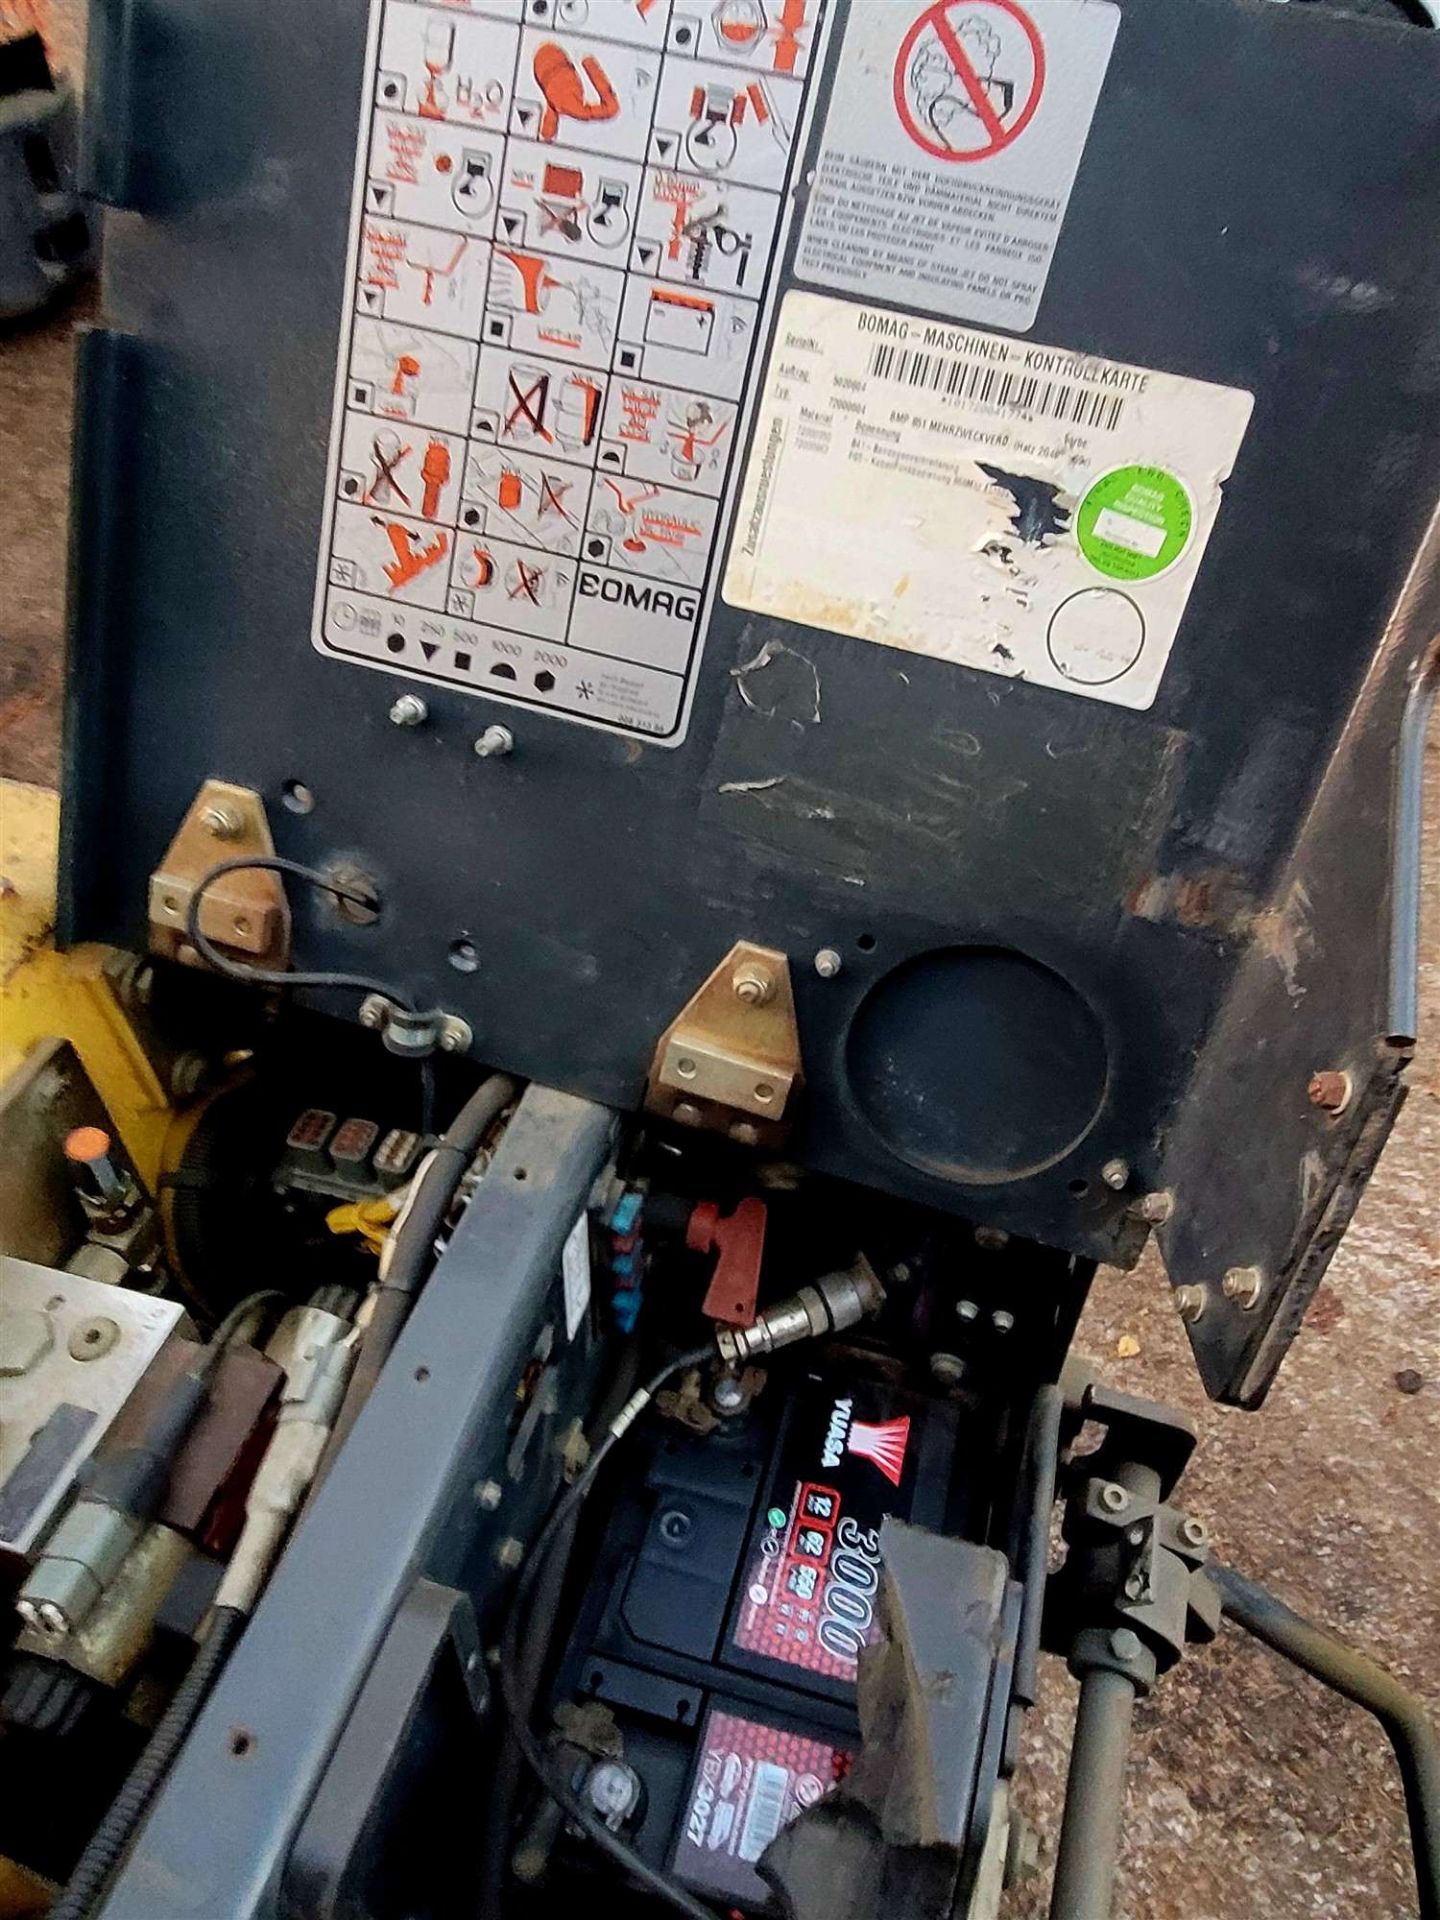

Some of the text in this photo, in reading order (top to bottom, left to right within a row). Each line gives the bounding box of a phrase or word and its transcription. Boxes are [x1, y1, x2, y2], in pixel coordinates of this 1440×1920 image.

[856, 311, 910, 341] BOMAG
[921, 326, 1010, 363] MASCHINEN
[577, 571, 697, 621] BOMAG
[819, 1394, 853, 1470] YUASA
[811, 1514, 888, 1668] 3000
